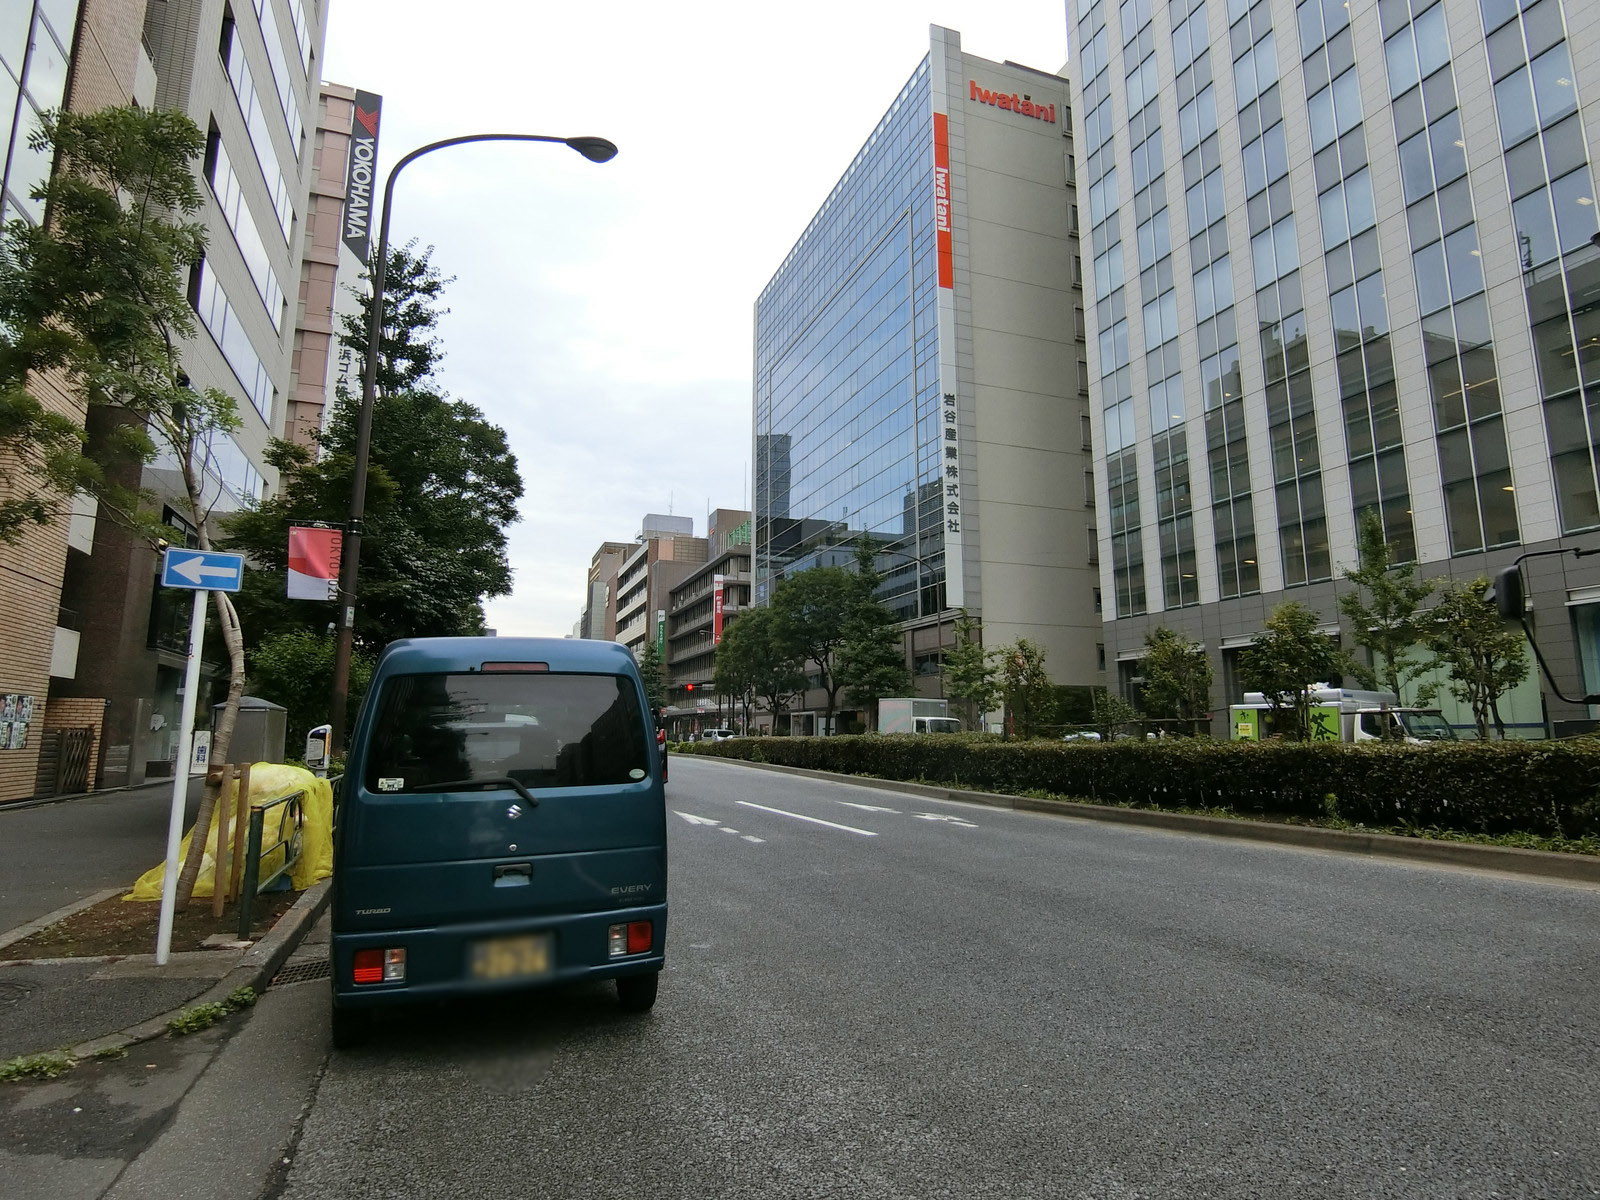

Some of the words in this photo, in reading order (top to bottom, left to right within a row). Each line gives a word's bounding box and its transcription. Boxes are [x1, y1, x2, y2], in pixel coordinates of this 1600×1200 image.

[969, 80, 1056, 123] Iwatani
[346, 137, 375, 240] YOKOHAMA
[936, 166, 950, 232] Iwatani
[943, 393, 960, 533] 岩谷産業株式会社
[329, 530, 342, 569] TOKYO
[327, 572, 340, 600] 2020
[611, 883, 652, 895] EVERY
[355, 907, 392, 915] TURBO
